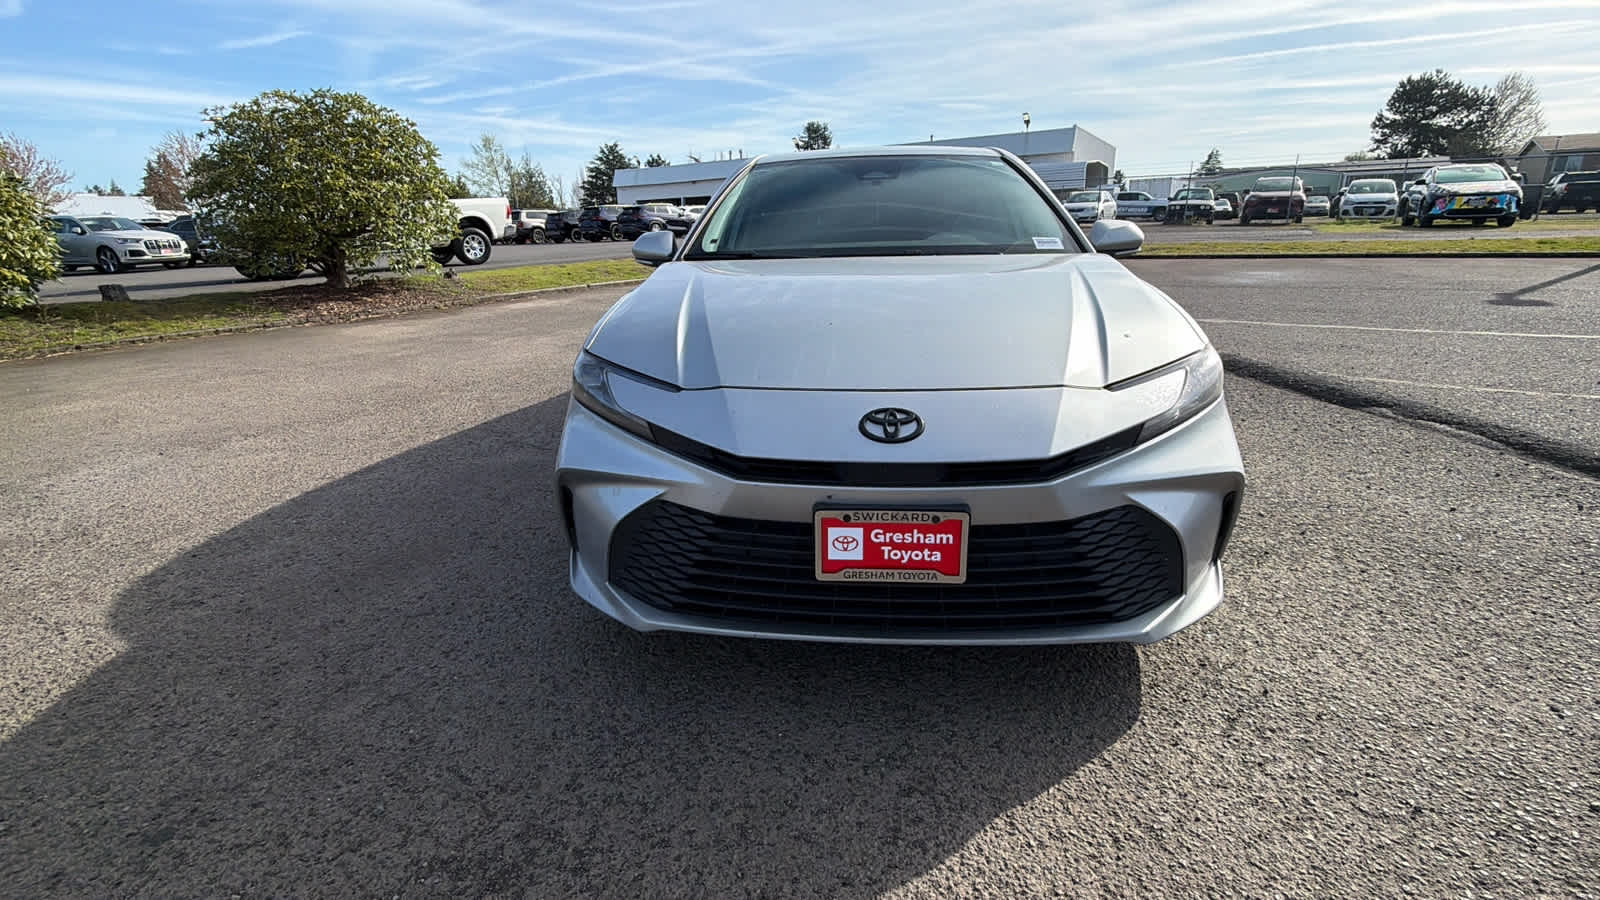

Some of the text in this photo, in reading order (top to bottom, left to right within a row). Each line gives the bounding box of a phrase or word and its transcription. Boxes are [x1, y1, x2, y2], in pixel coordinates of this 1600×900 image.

[853, 511, 930, 522] SWICKARD
[870, 529, 953, 544] Gresham
[881, 546, 942, 563] Toyota
[843, 571, 938, 581] GRESHAM TOYOTA
